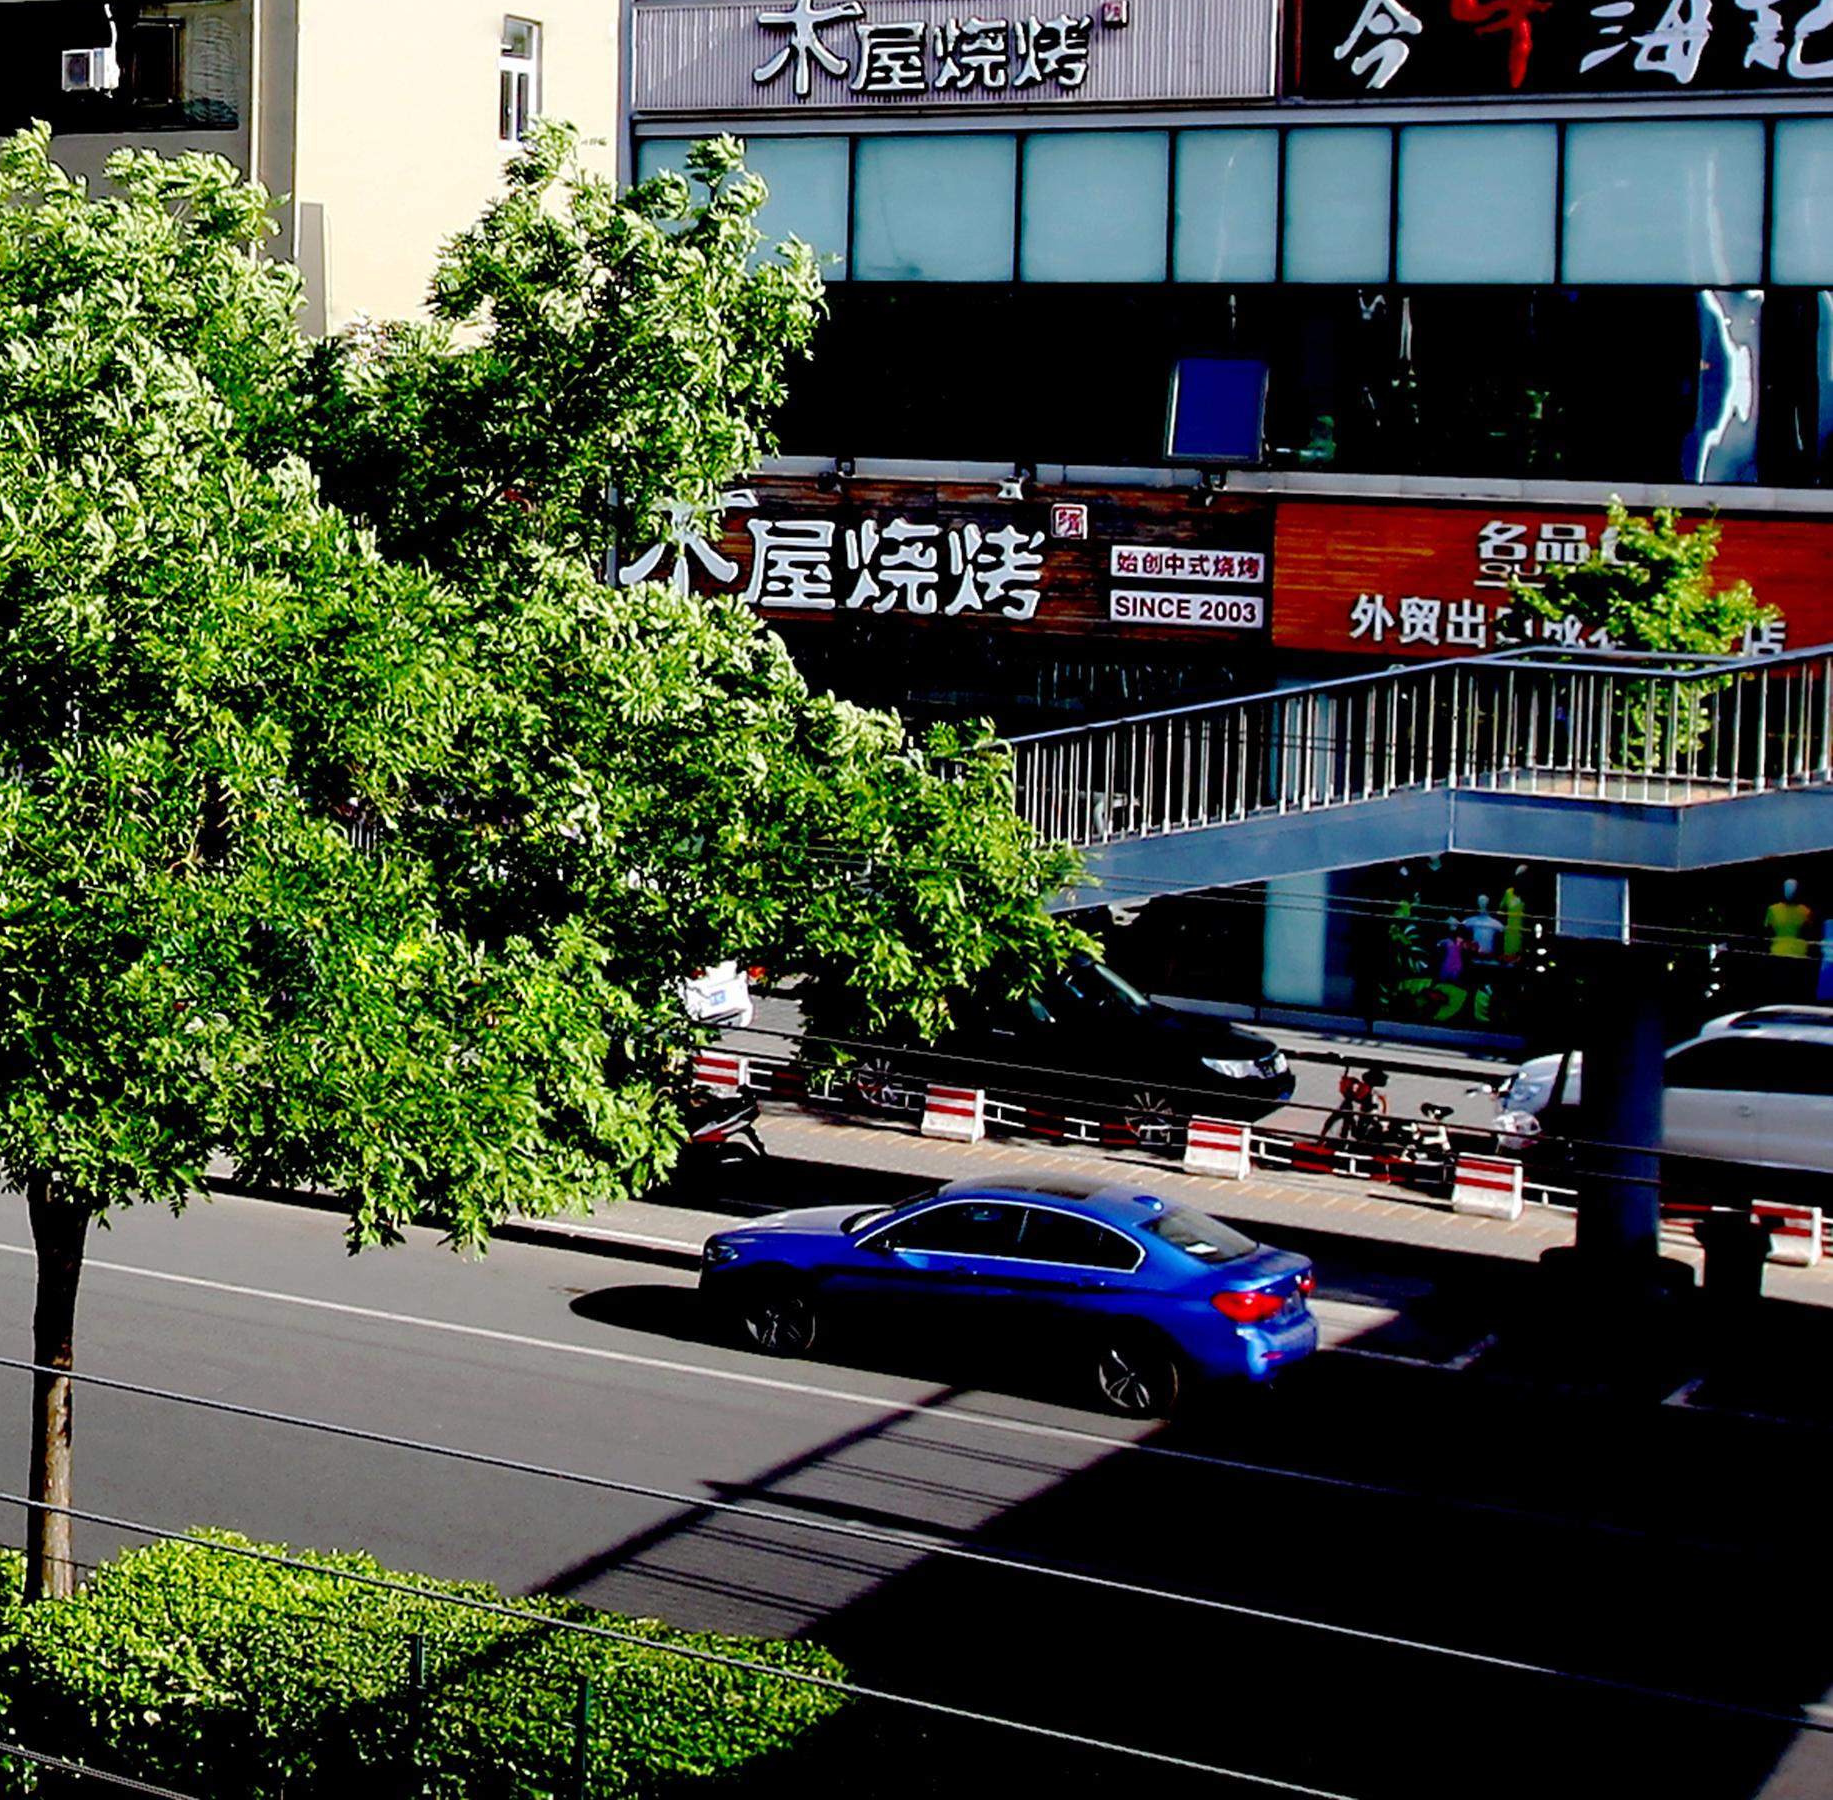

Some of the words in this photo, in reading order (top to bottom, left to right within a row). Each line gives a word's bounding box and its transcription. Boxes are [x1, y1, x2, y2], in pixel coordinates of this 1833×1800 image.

[619, 488, 1045, 620] 木屋烧烤
[1117, 552, 1260, 579] 始创中式烧烤
[1115, 596, 1192, 620] SINCE
[1199, 601, 1257, 623] 2003
